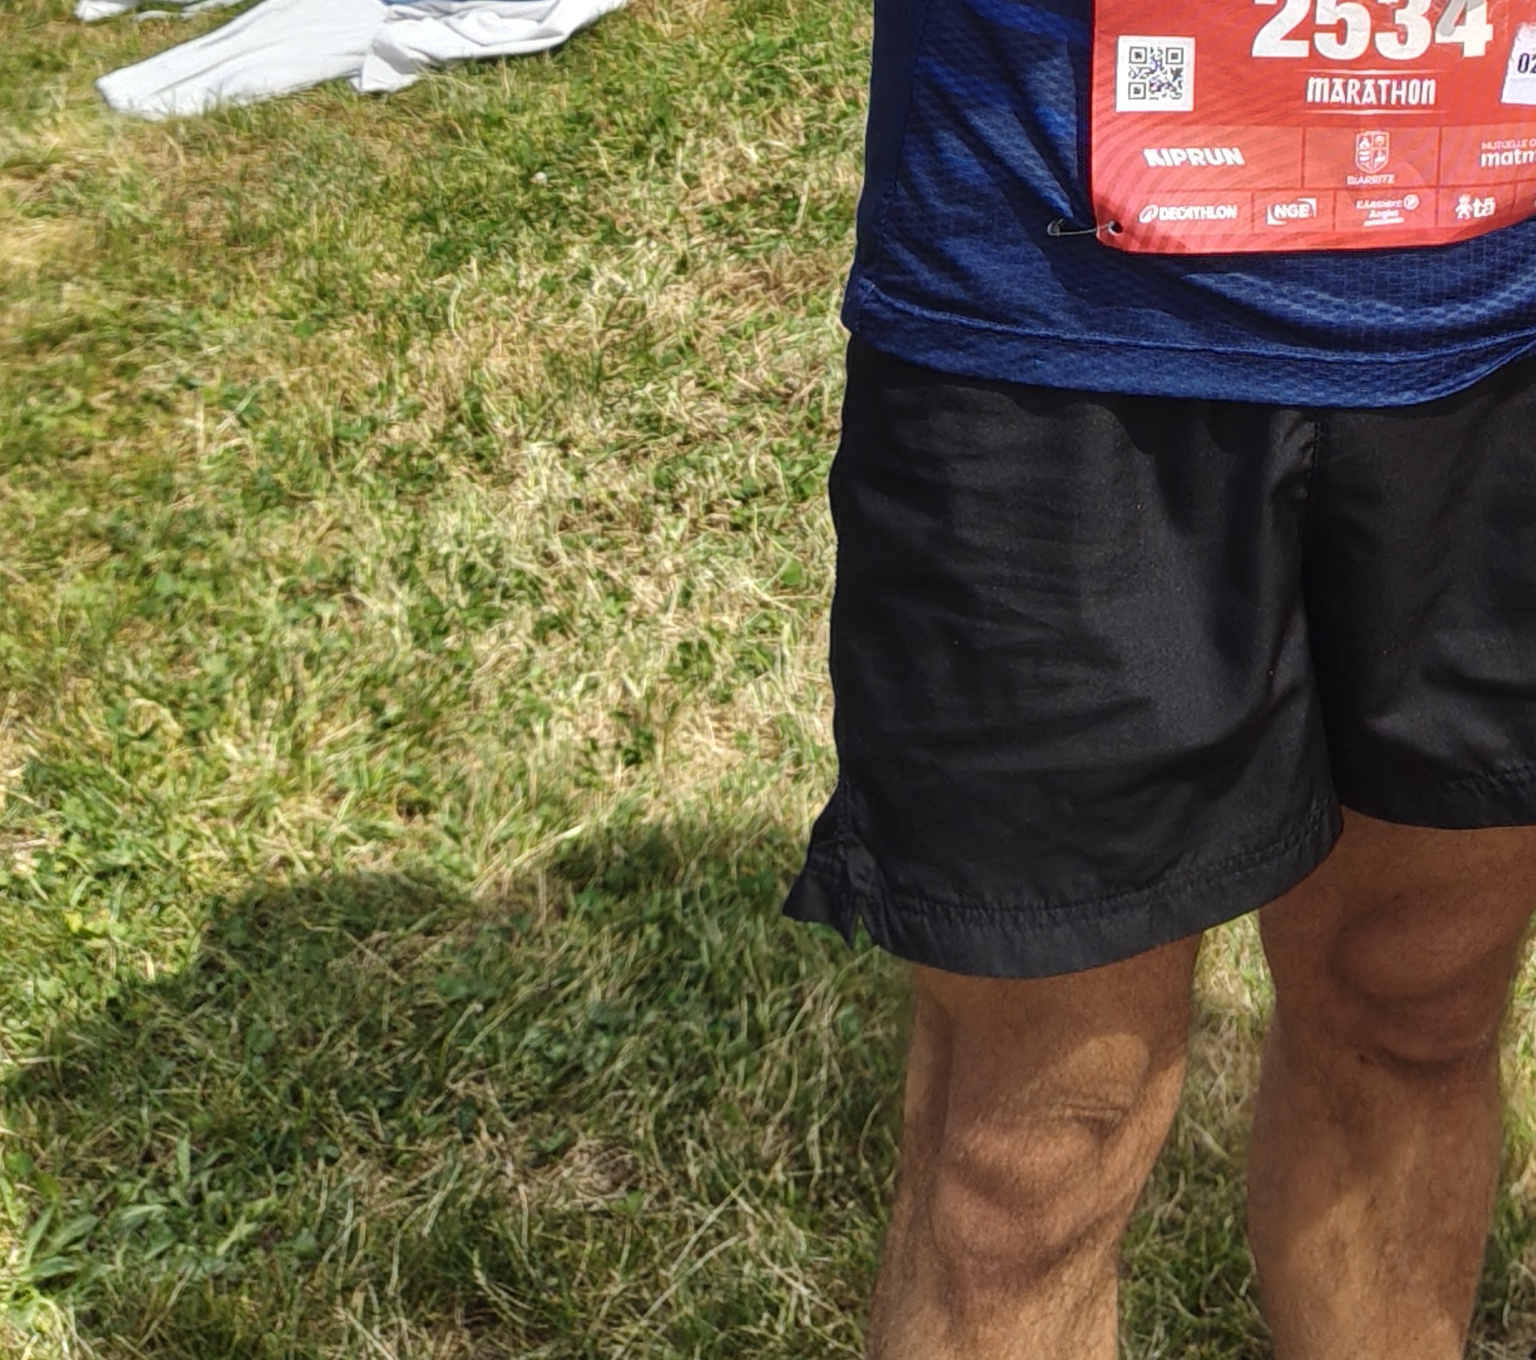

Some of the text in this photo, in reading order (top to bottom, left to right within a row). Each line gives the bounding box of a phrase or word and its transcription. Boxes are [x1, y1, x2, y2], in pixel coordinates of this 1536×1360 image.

[1306, 76, 1436, 105] MARATHON
[1143, 147, 1245, 167] KIPRUN
[1159, 204, 1238, 221] DECATHLON
[1274, 204, 1310, 218] NGE
